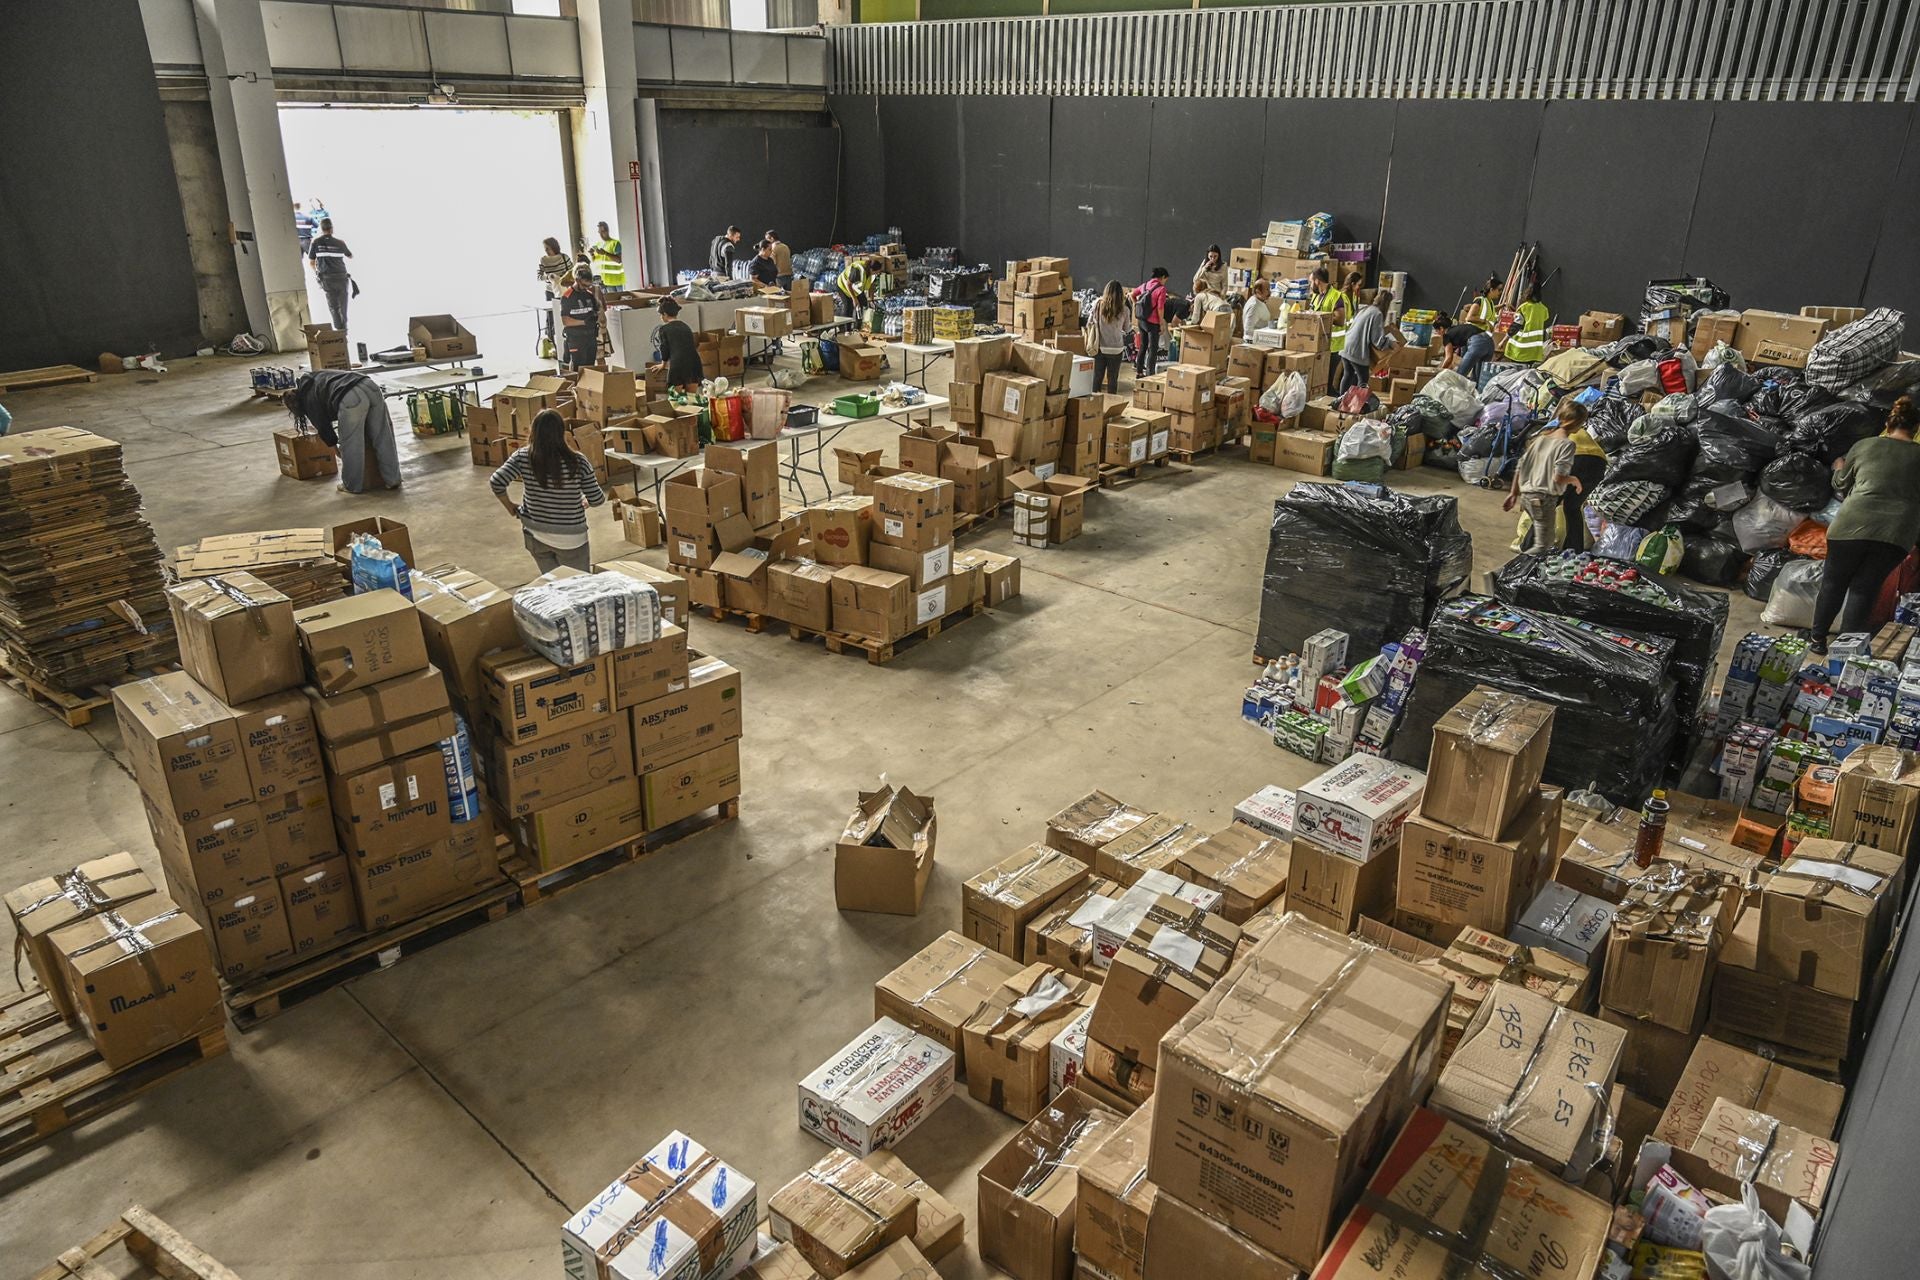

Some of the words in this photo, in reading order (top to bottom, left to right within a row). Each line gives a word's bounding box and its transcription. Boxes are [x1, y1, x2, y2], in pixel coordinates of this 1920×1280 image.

[550, 698, 582, 719] LINDOR
[663, 704, 689, 720] Pants
[540, 741, 571, 759] Pants
[258, 784, 276, 796] 80
[183, 808, 200, 822] 80
[516, 802, 530, 814] 80
[574, 811, 588, 825] iD
[399, 849, 433, 866] Pants
[206, 887, 224, 901] 80
[226, 962, 245, 976] 80
[827, 1034, 882, 1077] PRODUCTOS
[866, 1055, 918, 1097] ALIMENTOS
[874, 1061, 927, 1103] NATURALES
